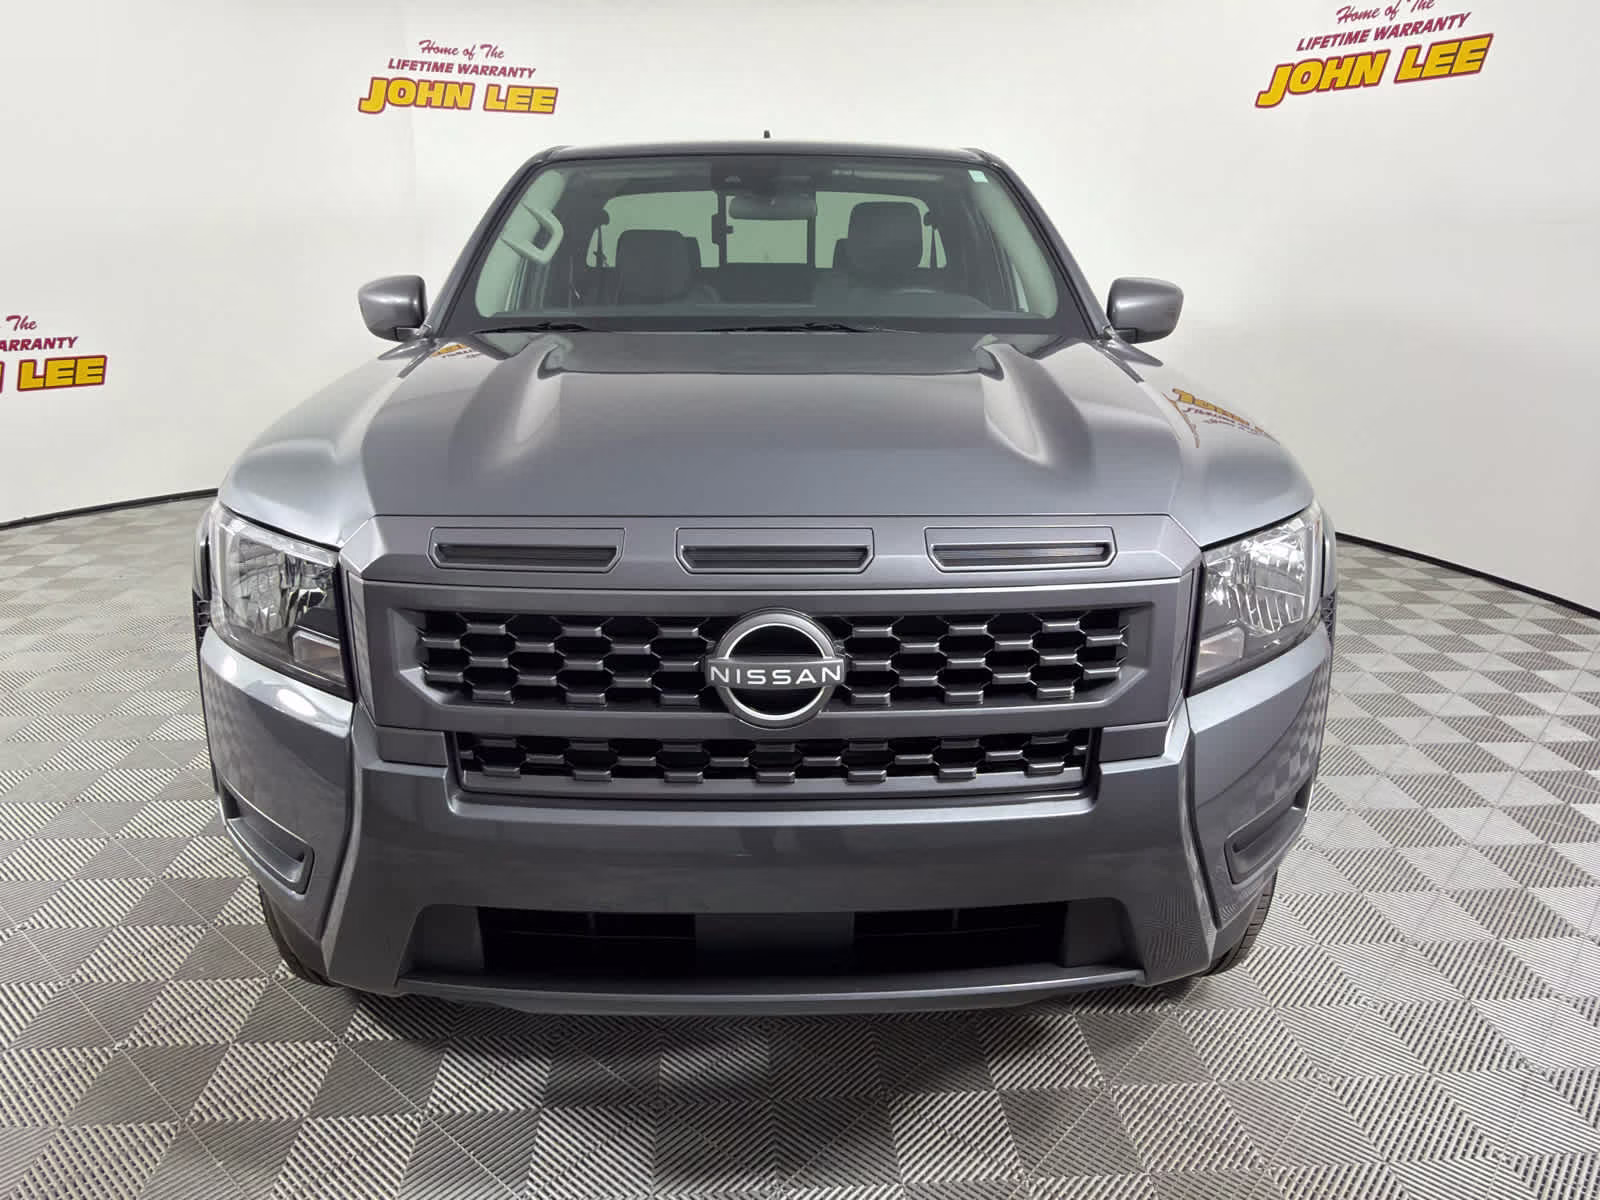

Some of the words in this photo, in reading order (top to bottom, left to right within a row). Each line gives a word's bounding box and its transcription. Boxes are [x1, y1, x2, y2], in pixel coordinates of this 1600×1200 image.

[1336, 5, 1380, 24] Home
[1384, 0, 1401, 20] of
[1296, 28, 1372, 52] LIFETIME
[1373, 12, 1472, 41] WARRANTY
[418, 39, 460, 56] Home
[462, 45, 476, 61] of
[480, 44, 505, 59] The
[388, 58, 454, 74] LIFETIME
[457, 63, 536, 79] WARRANTY
[1255, 49, 1391, 109] JOHN
[1394, 33, 1494, 84] LEE
[358, 77, 475, 114] JOHN
[483, 84, 558, 114] LEE
[5, 314, 38, 331] The
[0, 336, 79, 352] ARRANTY
[16, 354, 108, 392] LEE
[710, 665, 841, 685] NISSAN
